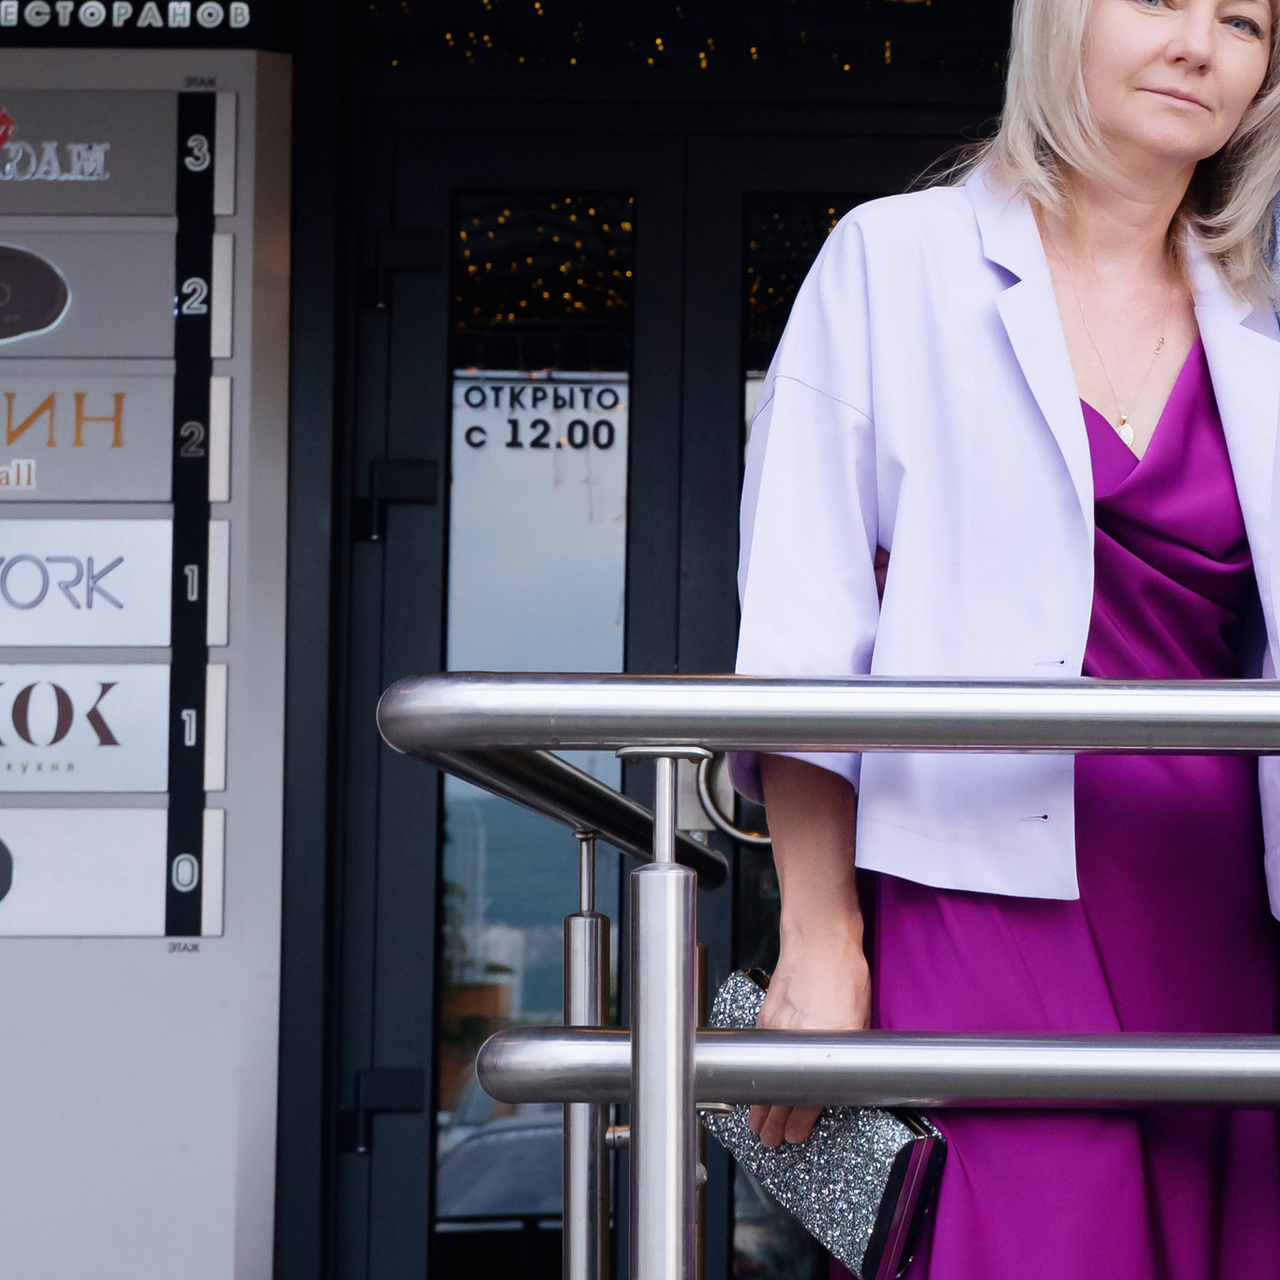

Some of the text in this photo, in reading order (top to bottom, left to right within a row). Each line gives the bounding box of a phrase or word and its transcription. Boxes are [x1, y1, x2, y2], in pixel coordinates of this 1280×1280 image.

[0, 0, 250, 28] ЕСТОРАНОВ
[184, 134, 211, 172] 3
[181, 277, 208, 315] 2
[464, 386, 619, 410] ОТКРЫТО
[4, 392, 125, 448] ИН
[505, 418, 615, 450] 12.00
[179, 421, 205, 458] 2
[0, 553, 124, 610] ORK
[184, 564, 199, 602] 1
[181, 709, 197, 747] 1
[6, 762, 75, 774] кухня
[171, 853, 199, 893] 0
